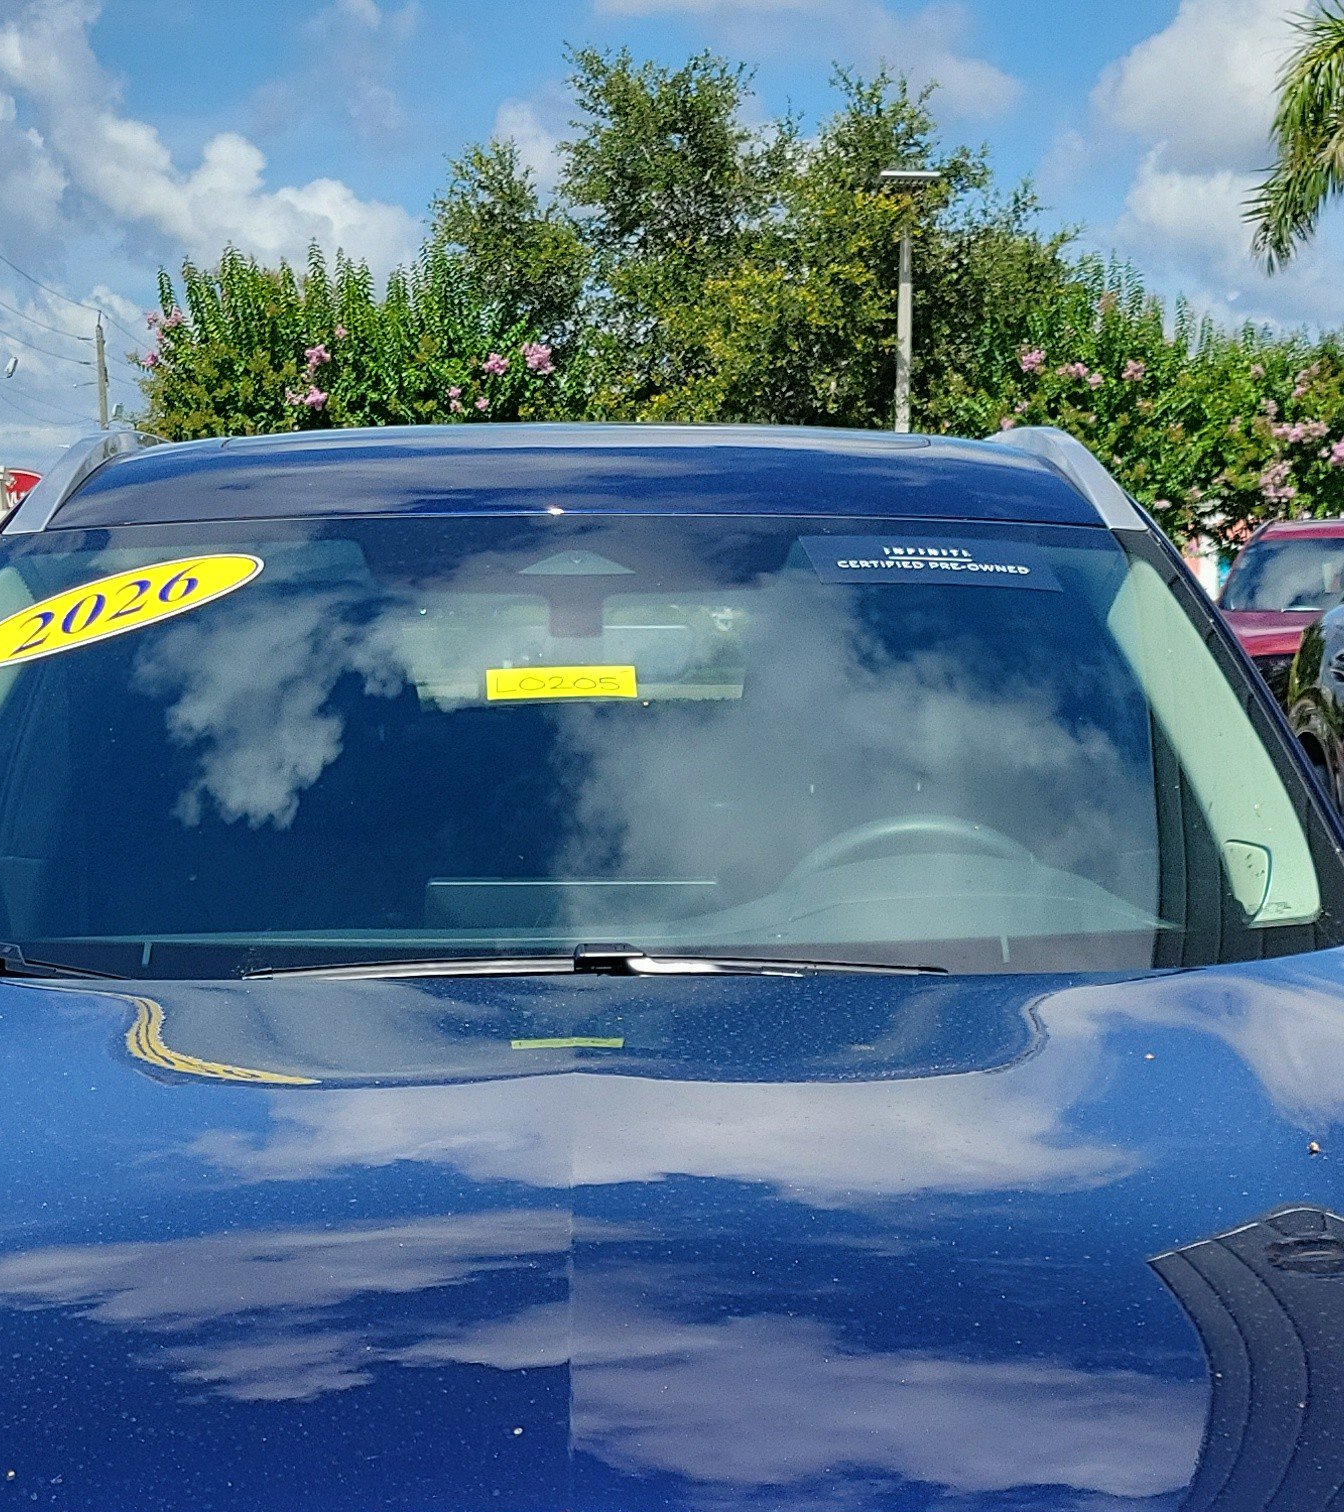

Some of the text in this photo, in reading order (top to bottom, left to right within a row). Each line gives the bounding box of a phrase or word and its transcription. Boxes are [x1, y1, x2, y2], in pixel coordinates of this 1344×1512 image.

[837, 560, 1030, 575] CERTIFIED PRE-OWNED
[9, 561, 205, 657] 2026
